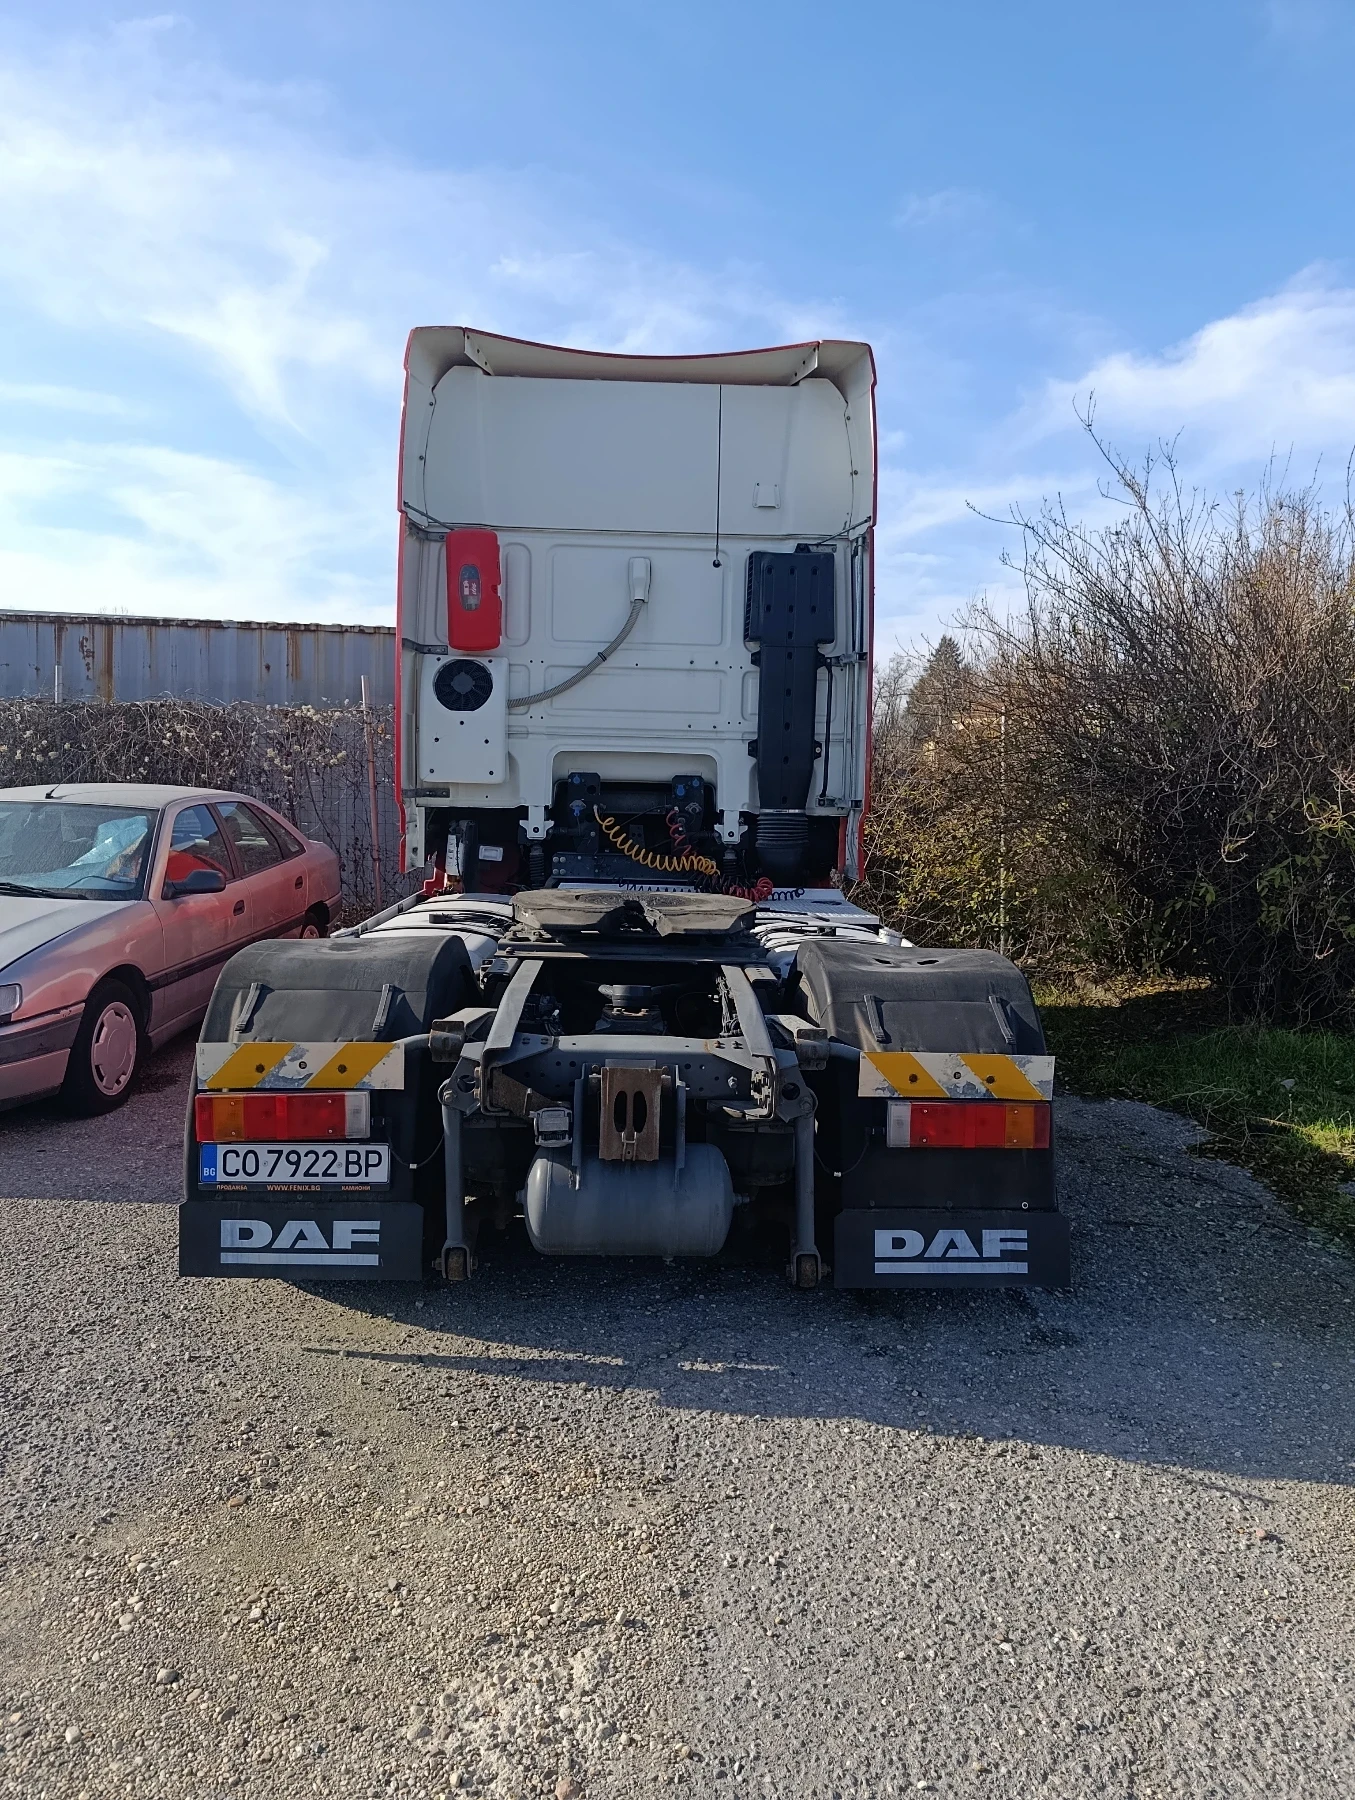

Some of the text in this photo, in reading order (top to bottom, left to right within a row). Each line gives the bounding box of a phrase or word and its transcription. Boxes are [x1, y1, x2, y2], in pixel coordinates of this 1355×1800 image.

[203, 1167, 216, 1177] BG
[266, 1184, 321, 1192] WWW.FENIX.BG
[220, 1219, 381, 1249] DAF
[874, 1229, 1028, 1258] DAF
